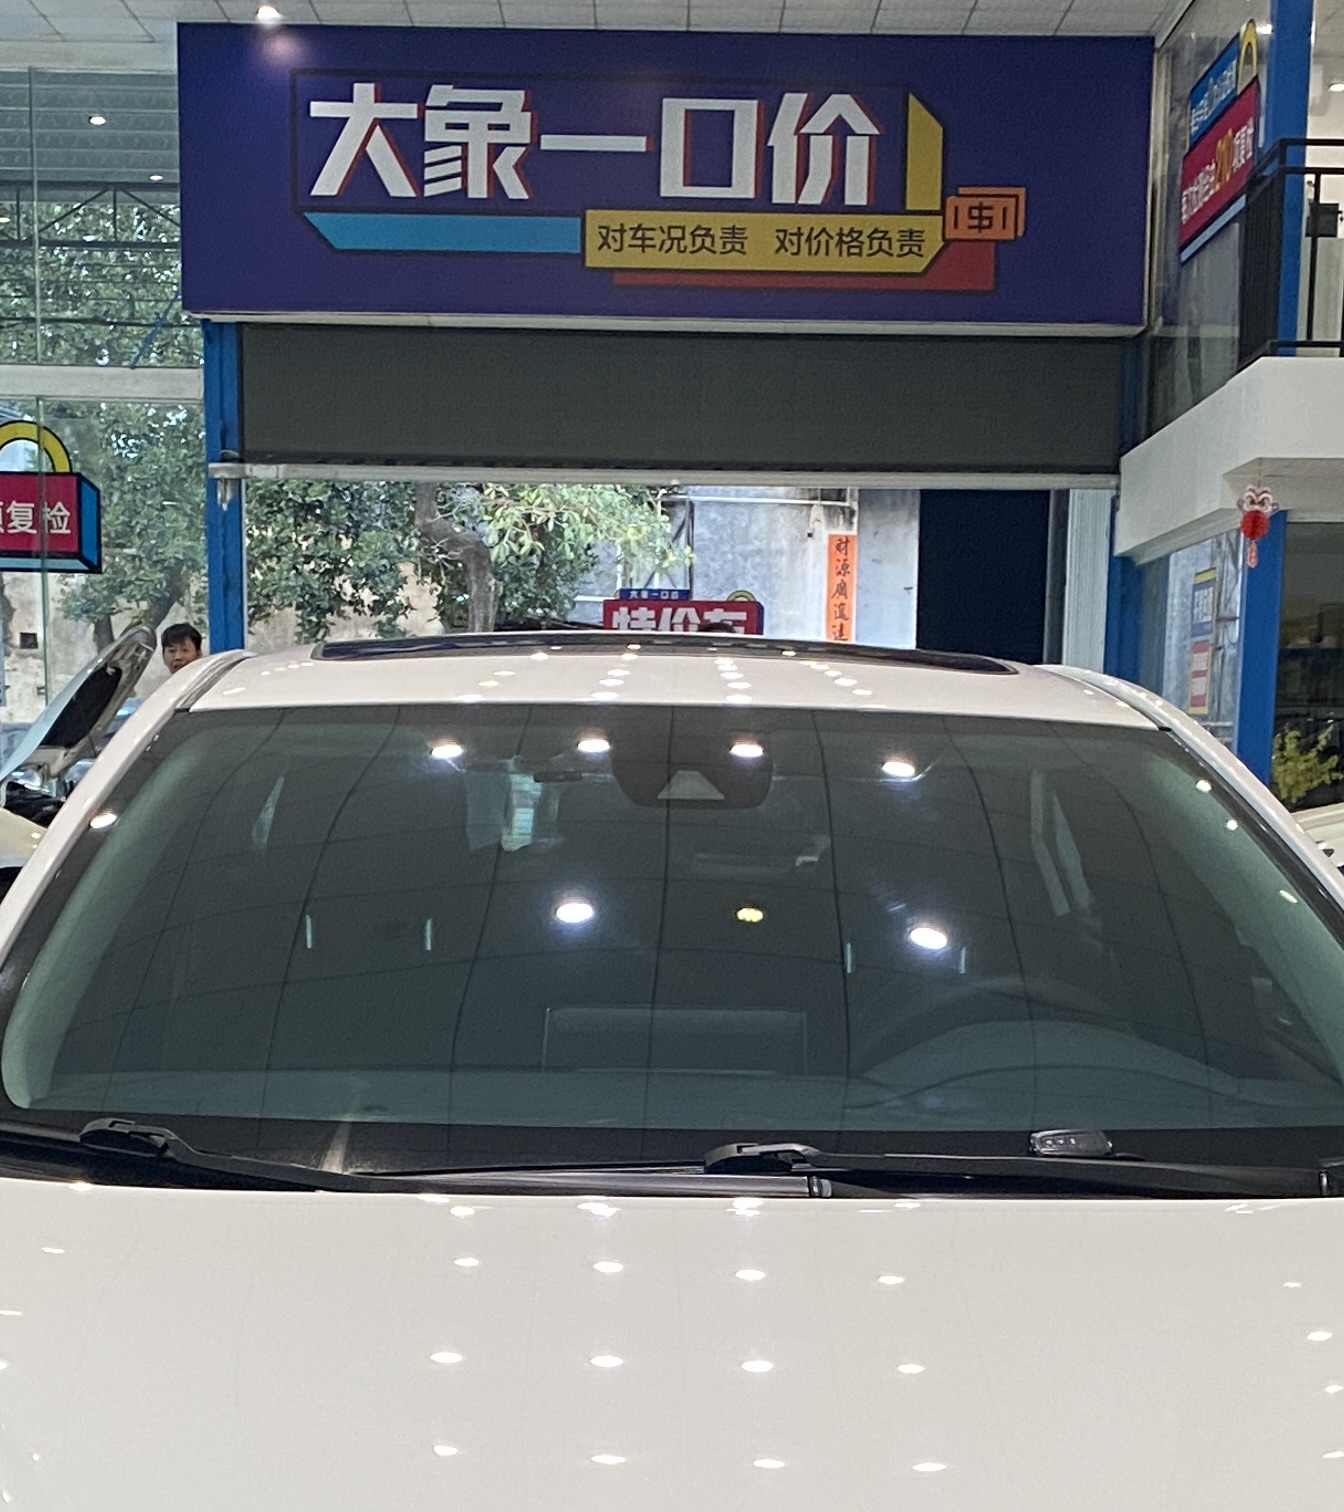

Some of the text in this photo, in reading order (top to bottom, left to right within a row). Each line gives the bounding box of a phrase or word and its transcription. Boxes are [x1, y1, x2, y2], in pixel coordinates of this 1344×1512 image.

[310, 83, 880, 206] 大象一口价
[597, 221, 926, 260] 对车况负责 对价格负责
